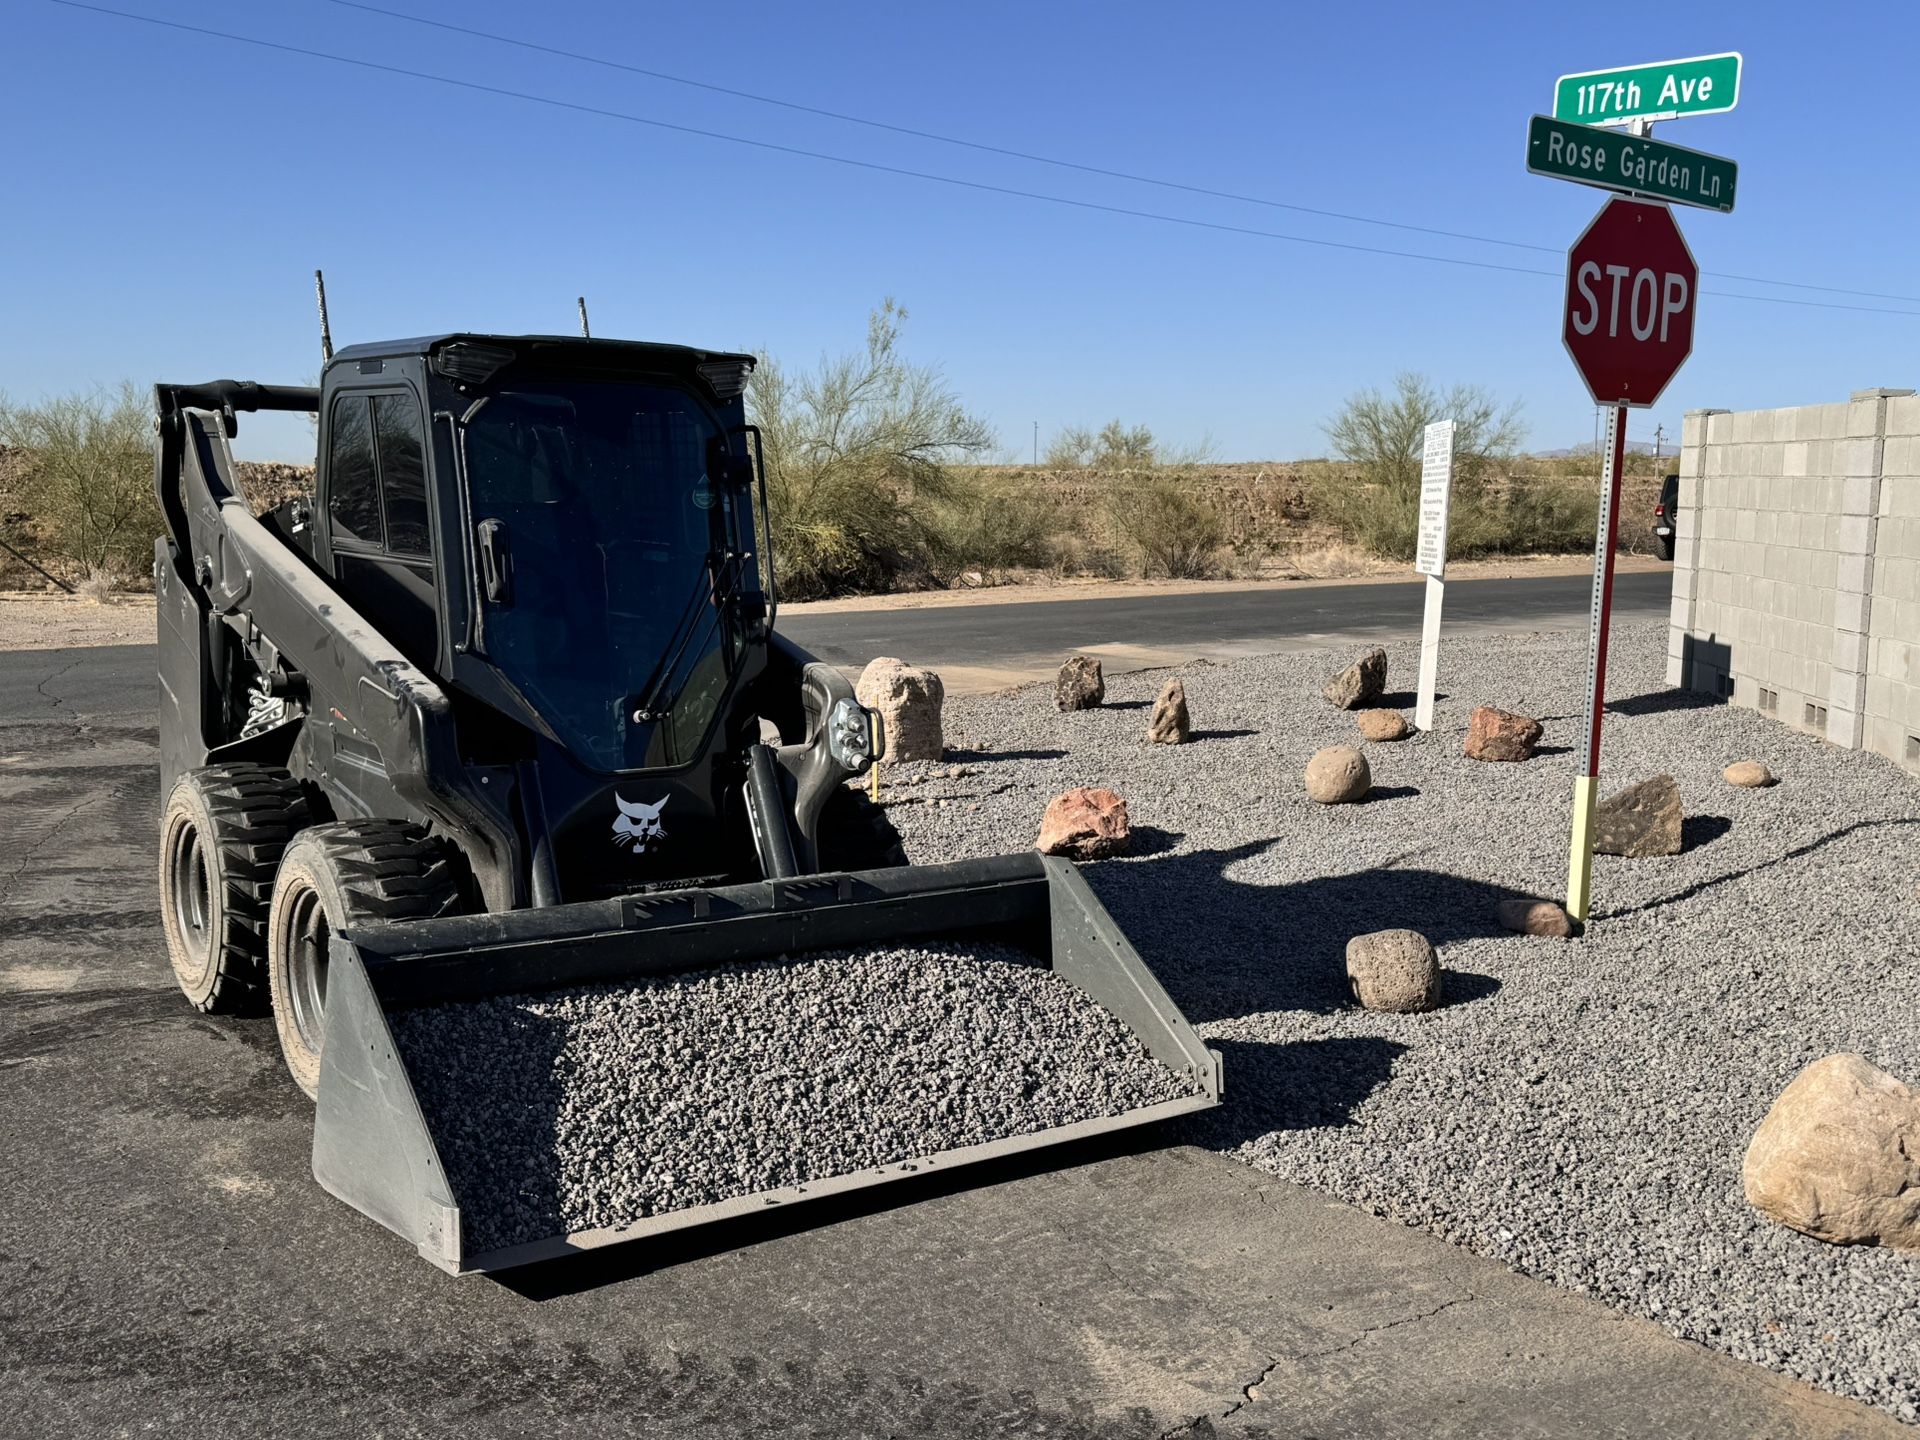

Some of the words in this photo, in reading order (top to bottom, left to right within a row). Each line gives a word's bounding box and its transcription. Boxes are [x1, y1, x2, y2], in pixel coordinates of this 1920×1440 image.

[1577, 80, 1641, 116] 117th
[1656, 74, 1713, 106] Ave
[1548, 130, 1606, 171] Rose
[1620, 146, 1689, 191] Garden
[1700, 165, 1720, 198] Ln
[1572, 260, 1688, 342] STOP
